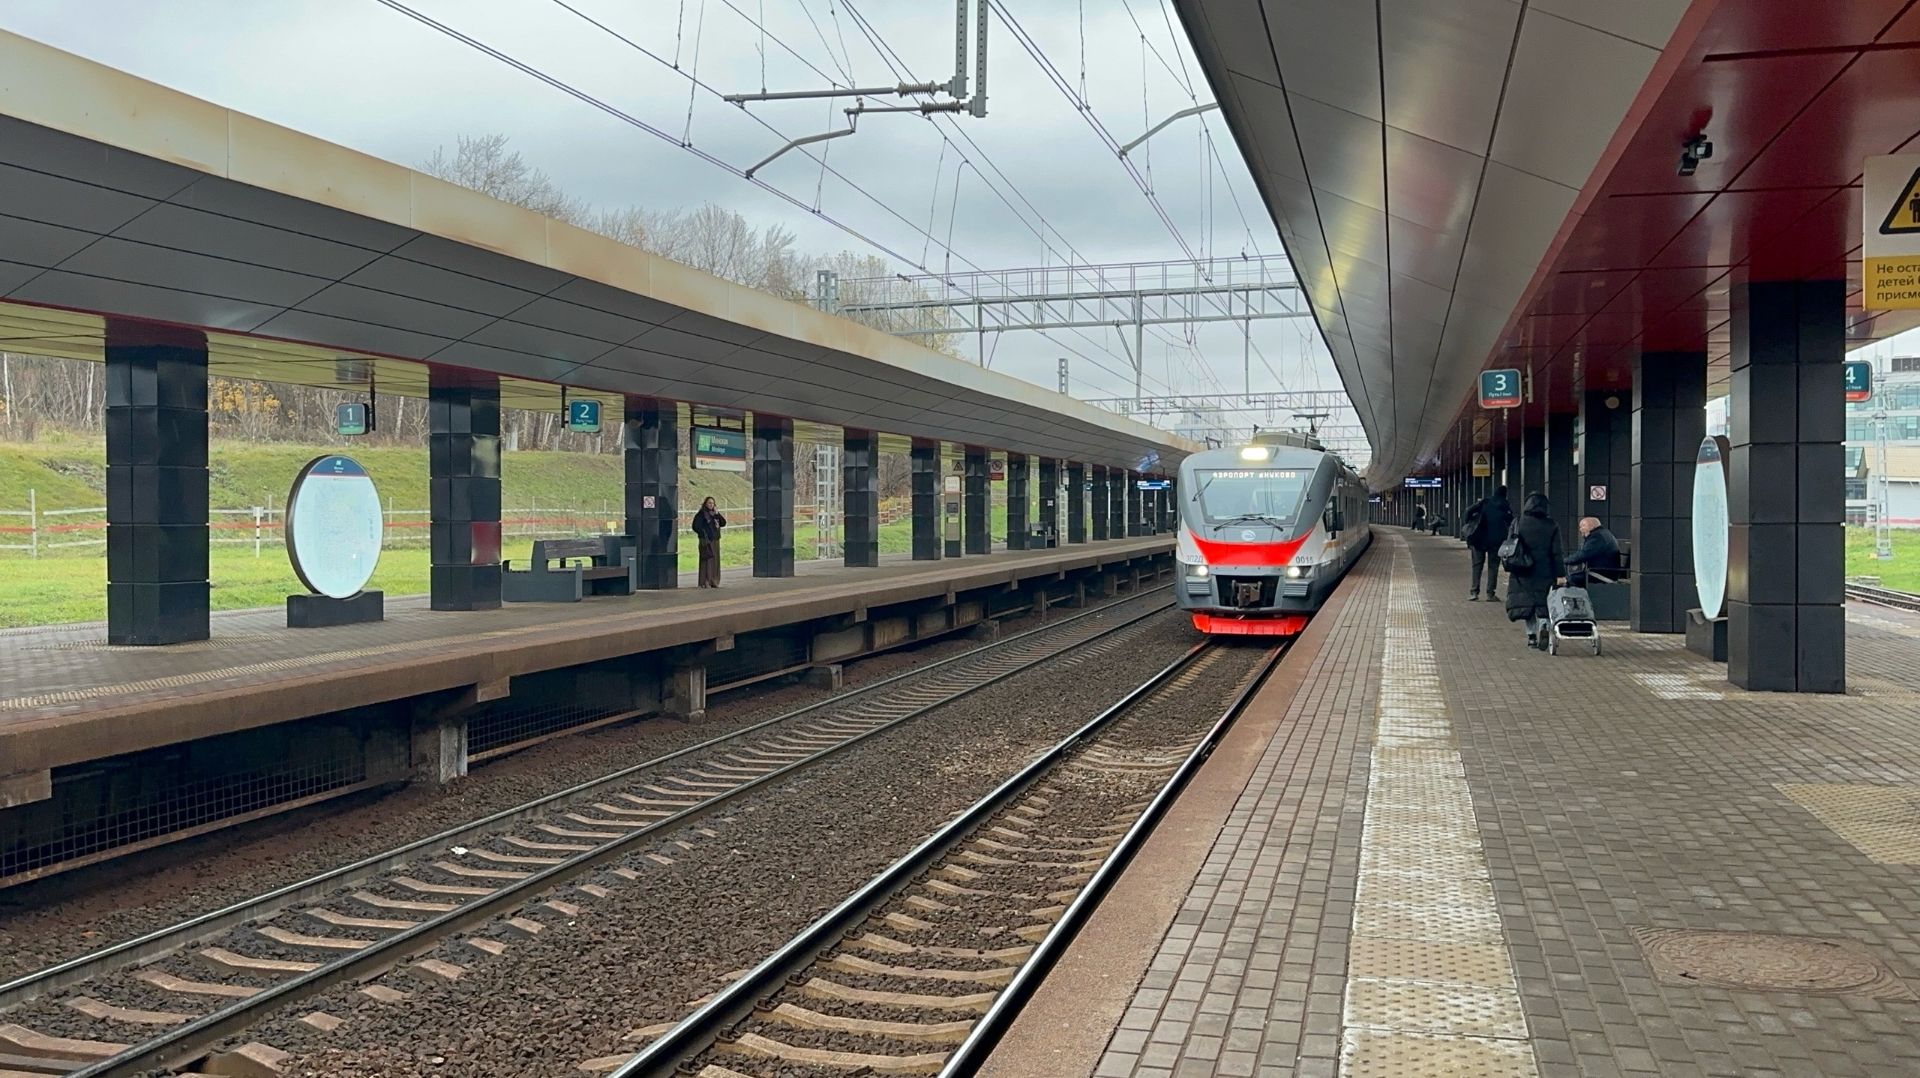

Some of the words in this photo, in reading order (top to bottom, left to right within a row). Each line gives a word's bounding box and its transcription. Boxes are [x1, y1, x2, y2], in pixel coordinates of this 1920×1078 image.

[1877, 264, 1893, 273] Не
[1877, 275, 1914, 288] детей
[1846, 366, 1856, 384] 4
[1495, 374, 1507, 391] 3
[346, 407, 353, 421] 1
[580, 404, 590, 418] 2
